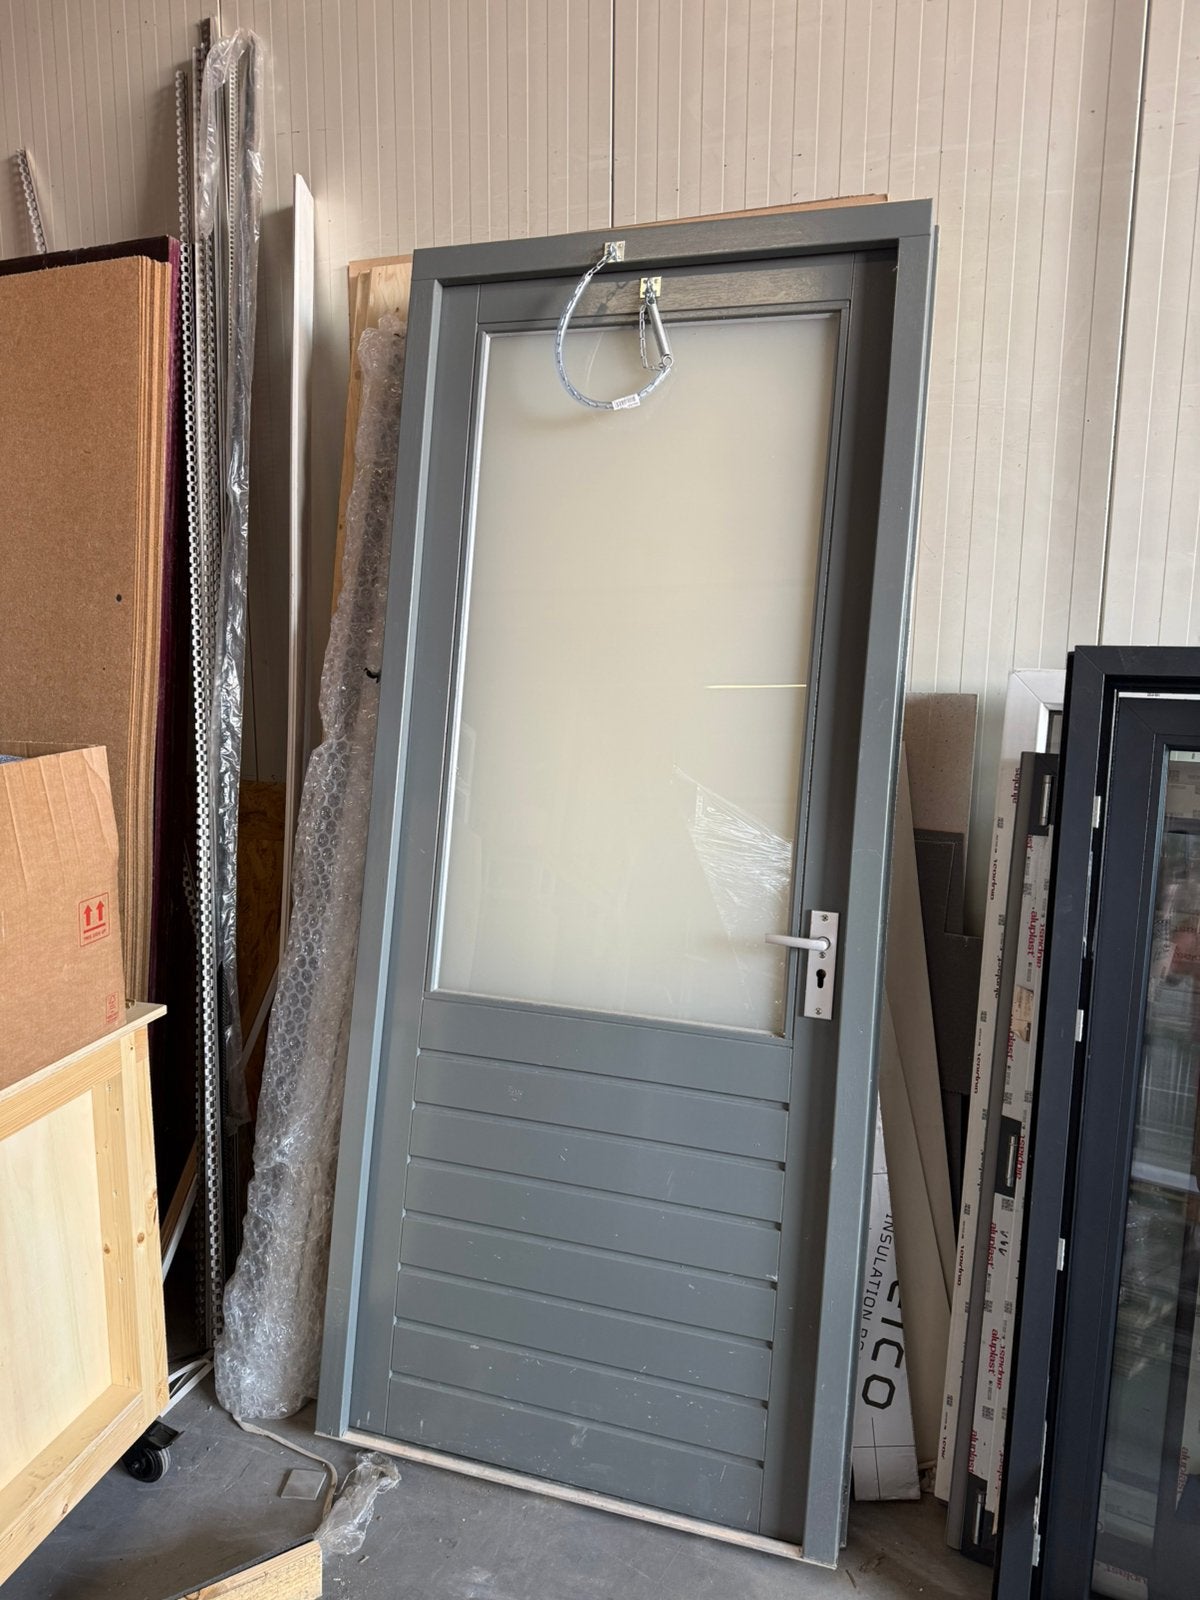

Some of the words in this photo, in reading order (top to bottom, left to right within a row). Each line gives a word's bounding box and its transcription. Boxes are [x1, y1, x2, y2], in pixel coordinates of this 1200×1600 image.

[1027, 910, 1039, 956] aluplast
[861, 1213, 894, 1321] INSULATION
[988, 1328, 999, 1374] aluplast
